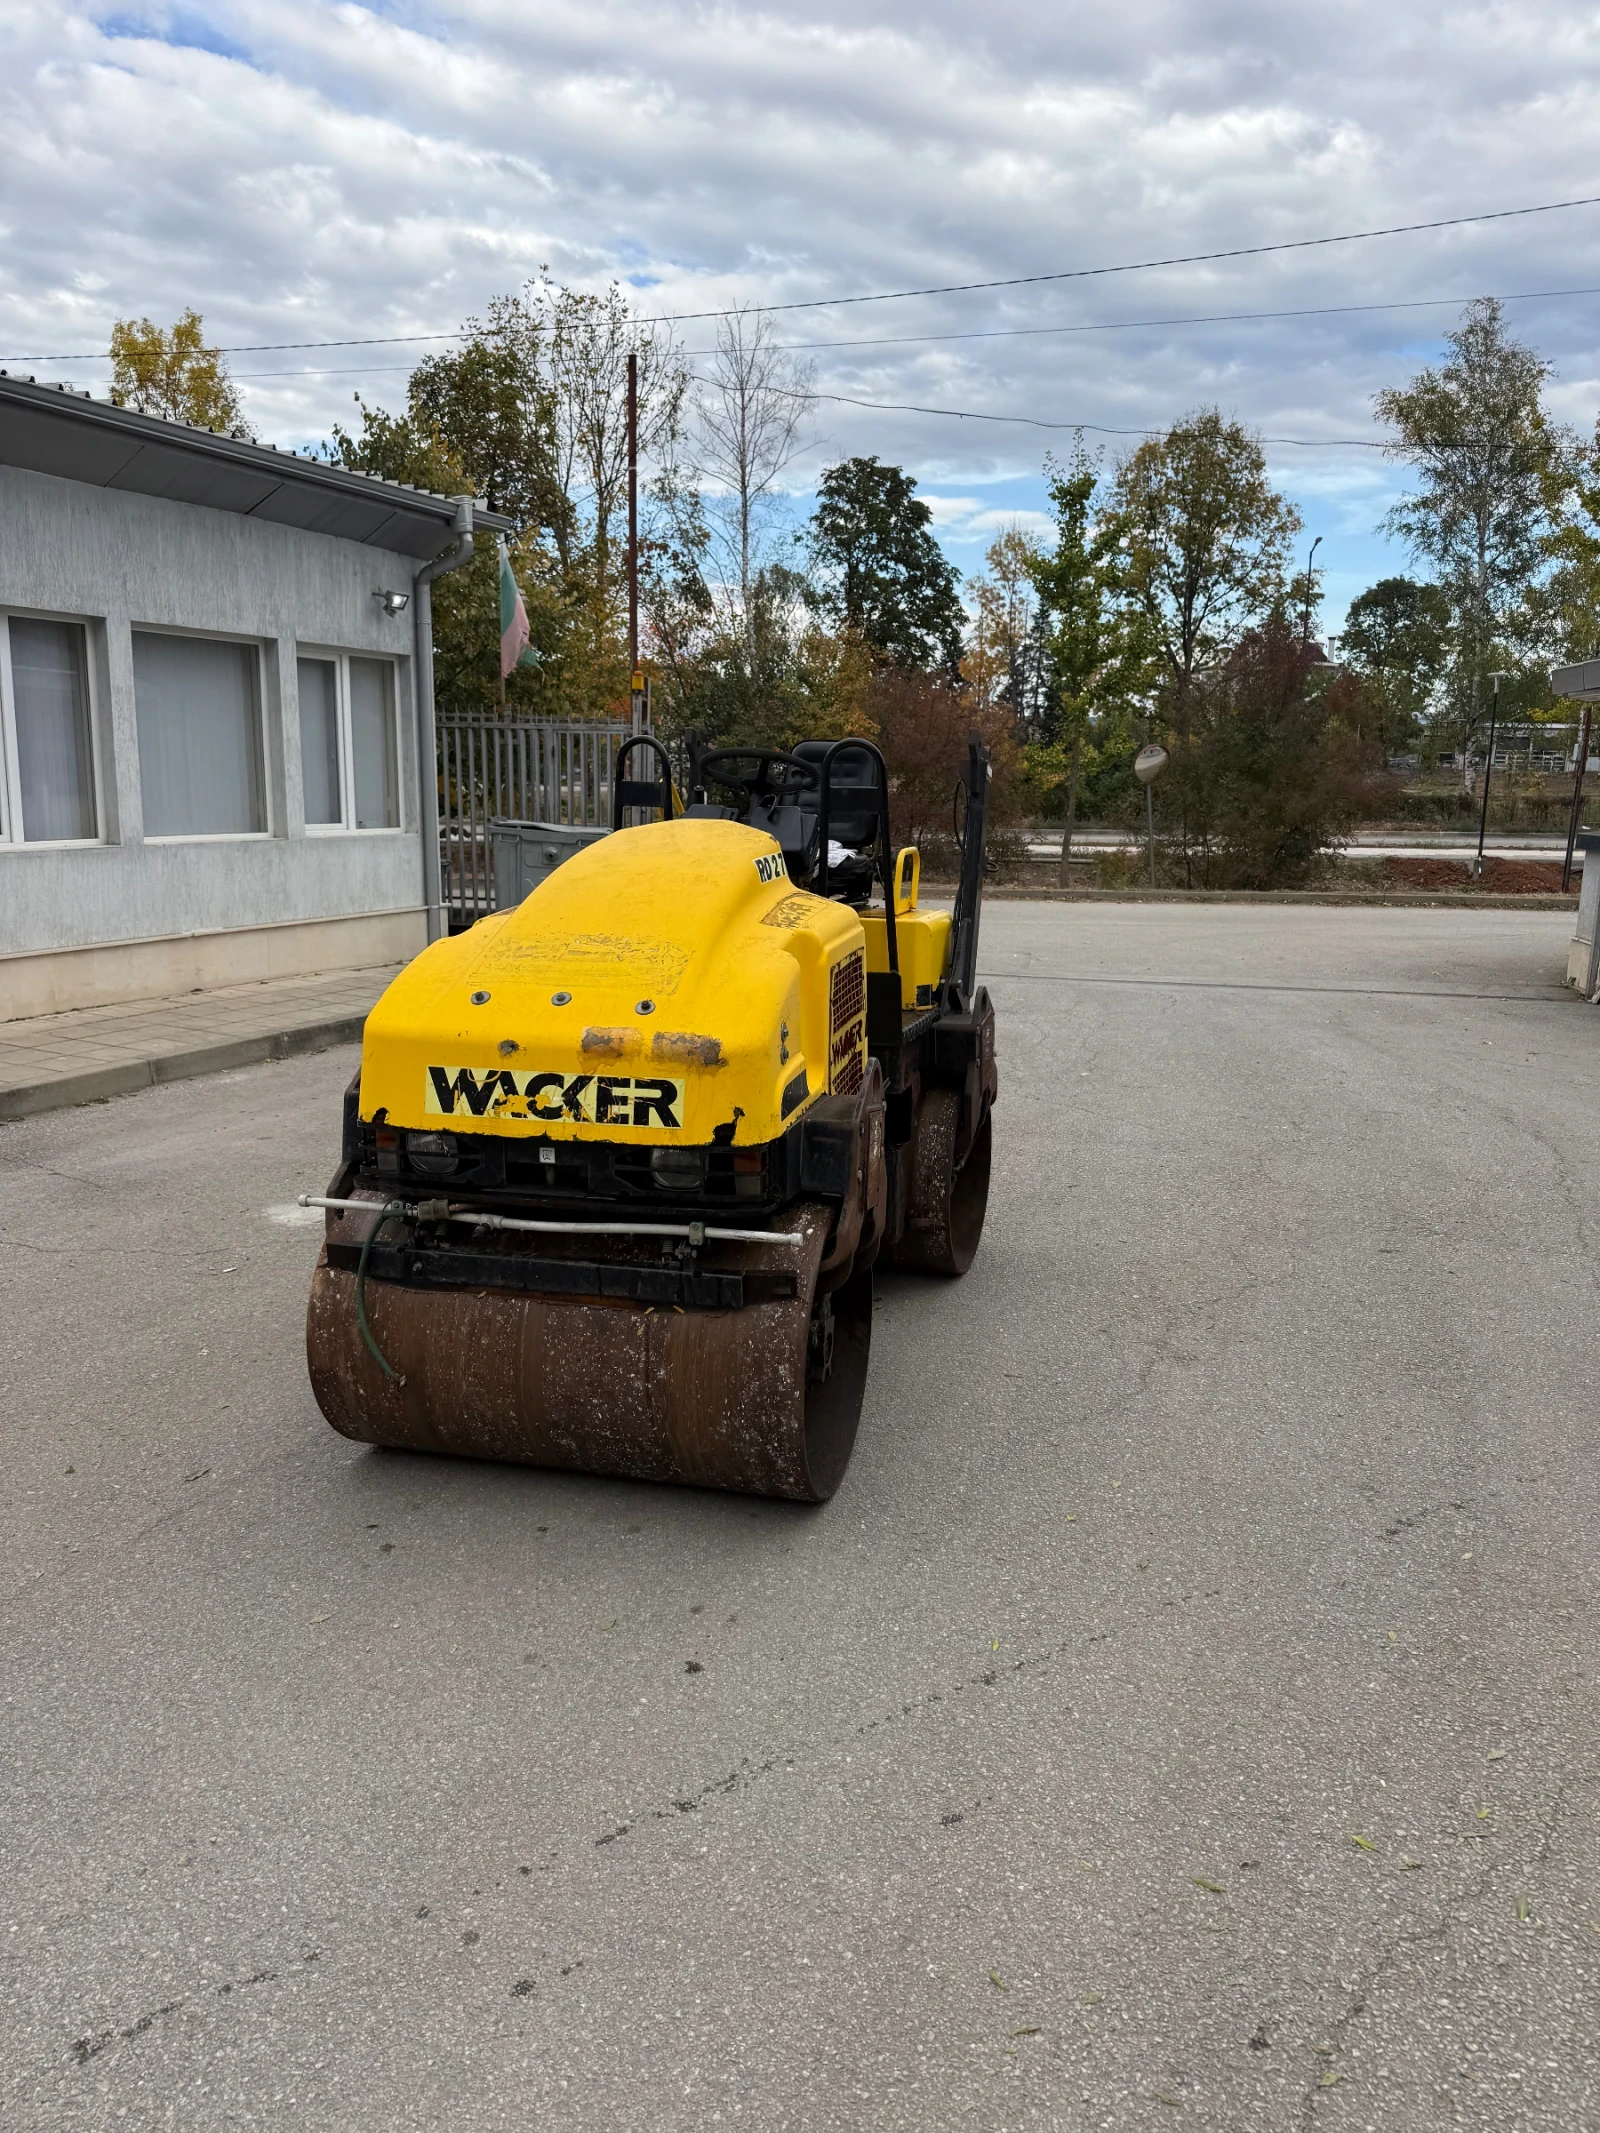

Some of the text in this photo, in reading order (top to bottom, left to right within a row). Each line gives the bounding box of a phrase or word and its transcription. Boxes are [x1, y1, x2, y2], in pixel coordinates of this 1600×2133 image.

[755, 853, 785, 883] RD 27
[428, 1066, 681, 1128] WACKER
